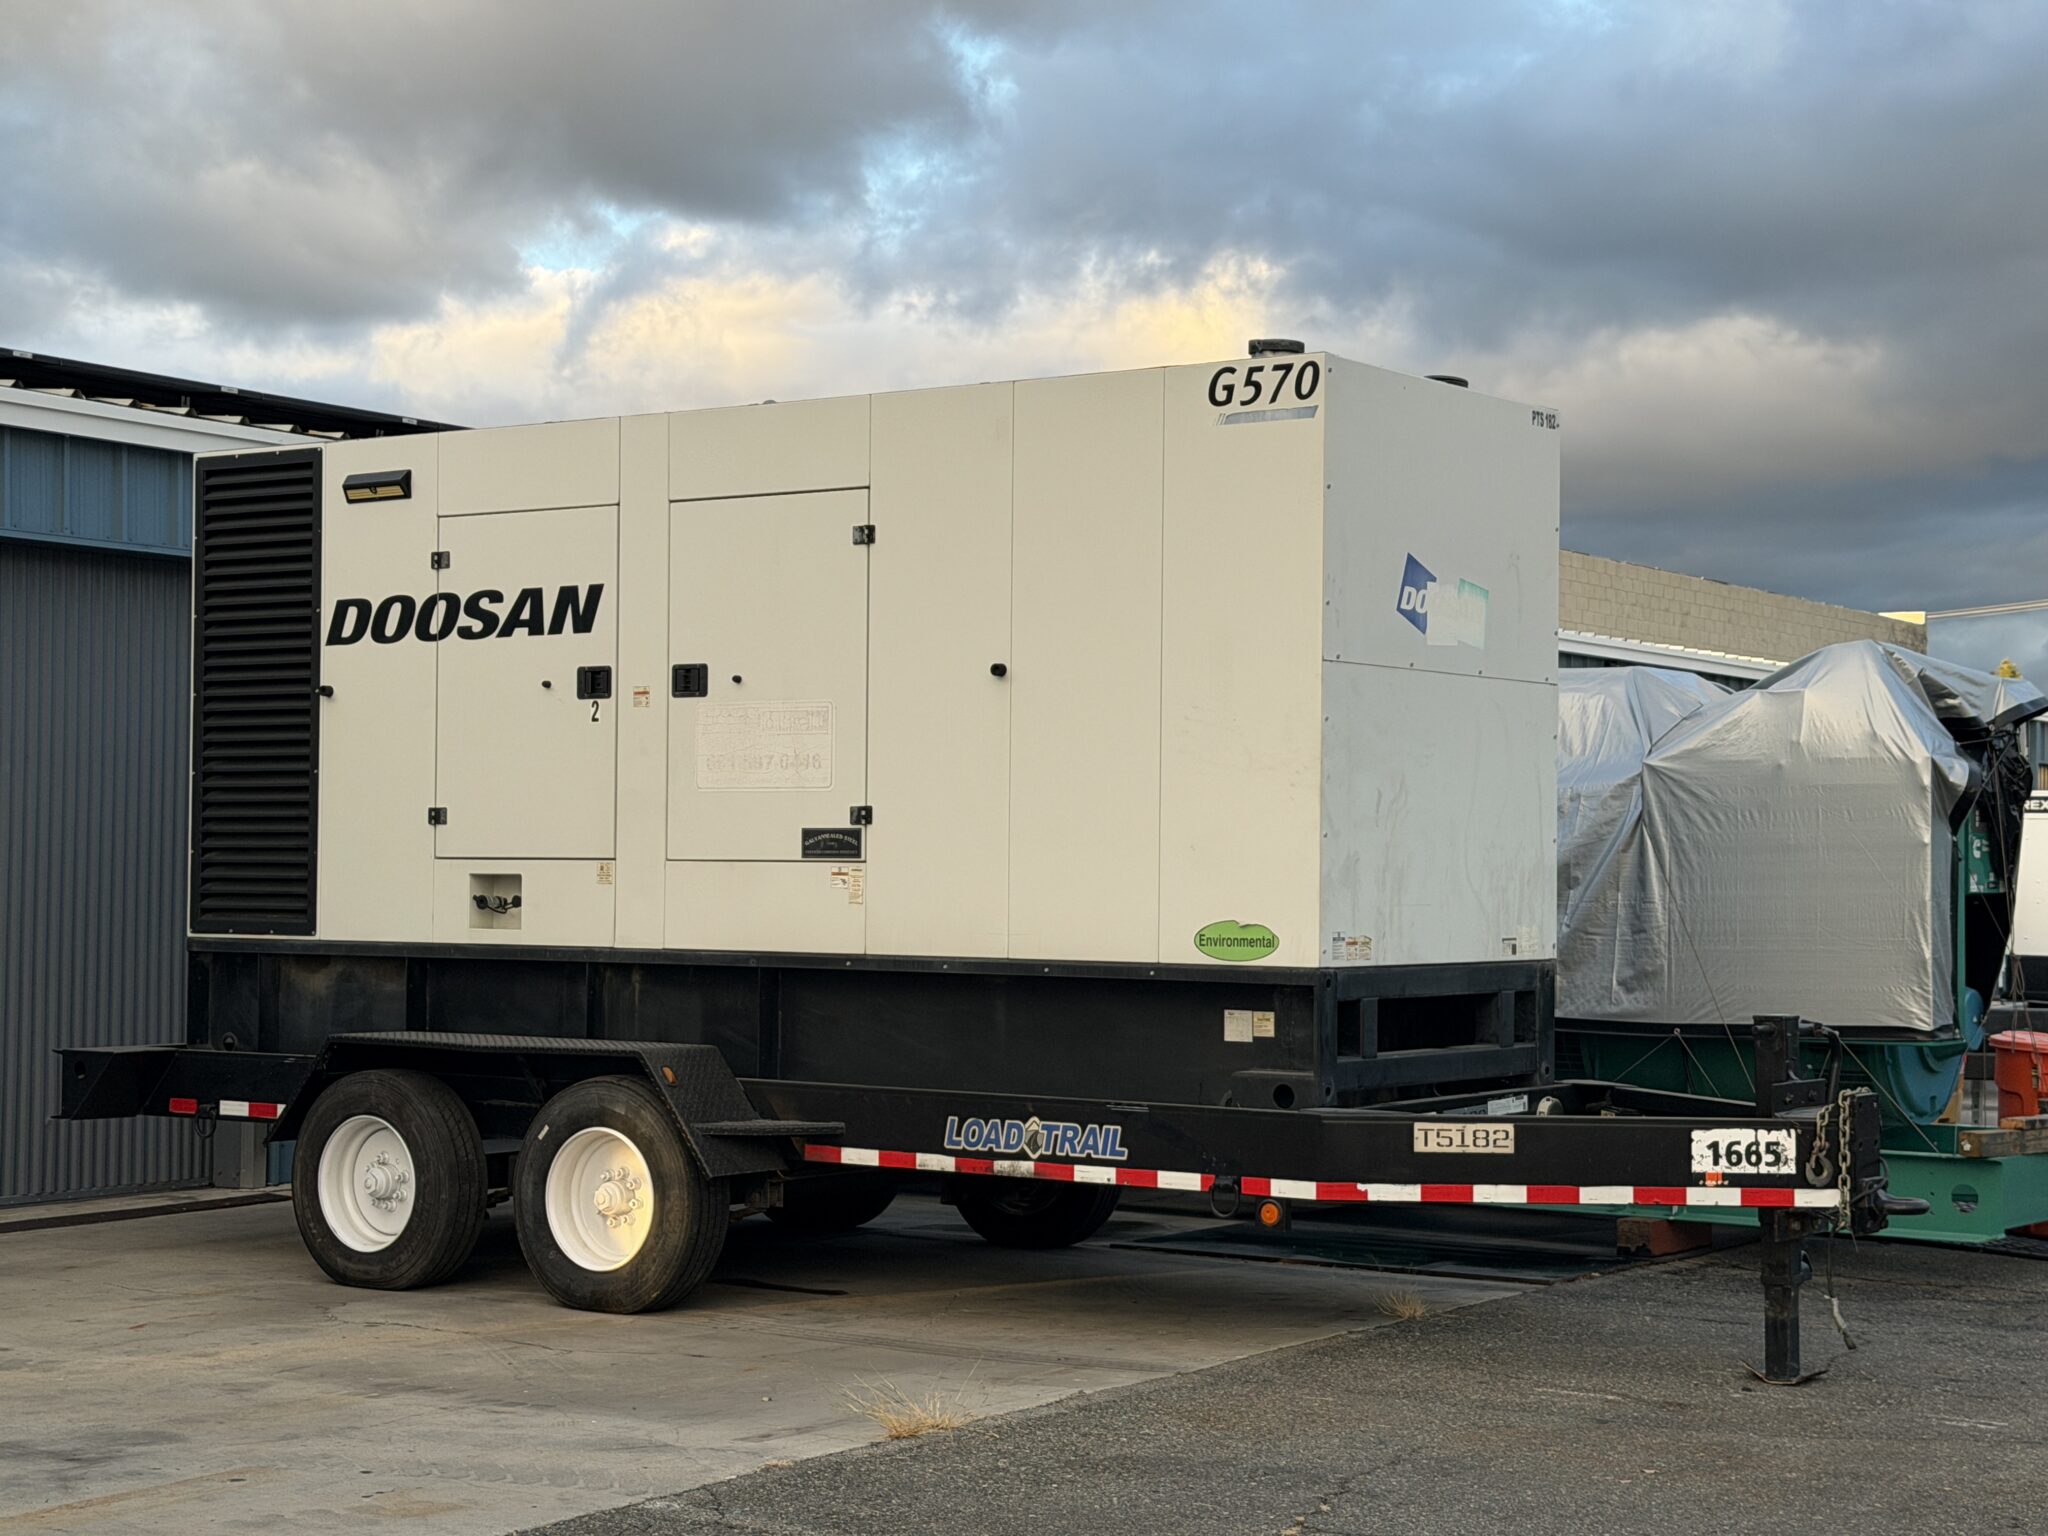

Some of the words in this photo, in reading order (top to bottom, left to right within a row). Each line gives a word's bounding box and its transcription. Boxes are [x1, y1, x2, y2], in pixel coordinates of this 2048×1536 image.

[1208, 361, 1320, 406] G570
[1532, 410, 1544, 428] PTS
[325, 583, 604, 646] DOOSAN
[591, 700, 599, 722] 2
[1198, 934, 1275, 949] Environmental
[944, 1116, 1026, 1154] LOAD
[1038, 1120, 1128, 1160] TRAIL
[1417, 1128, 1509, 1149] T5182
[1706, 1140, 1781, 1168] 1665
